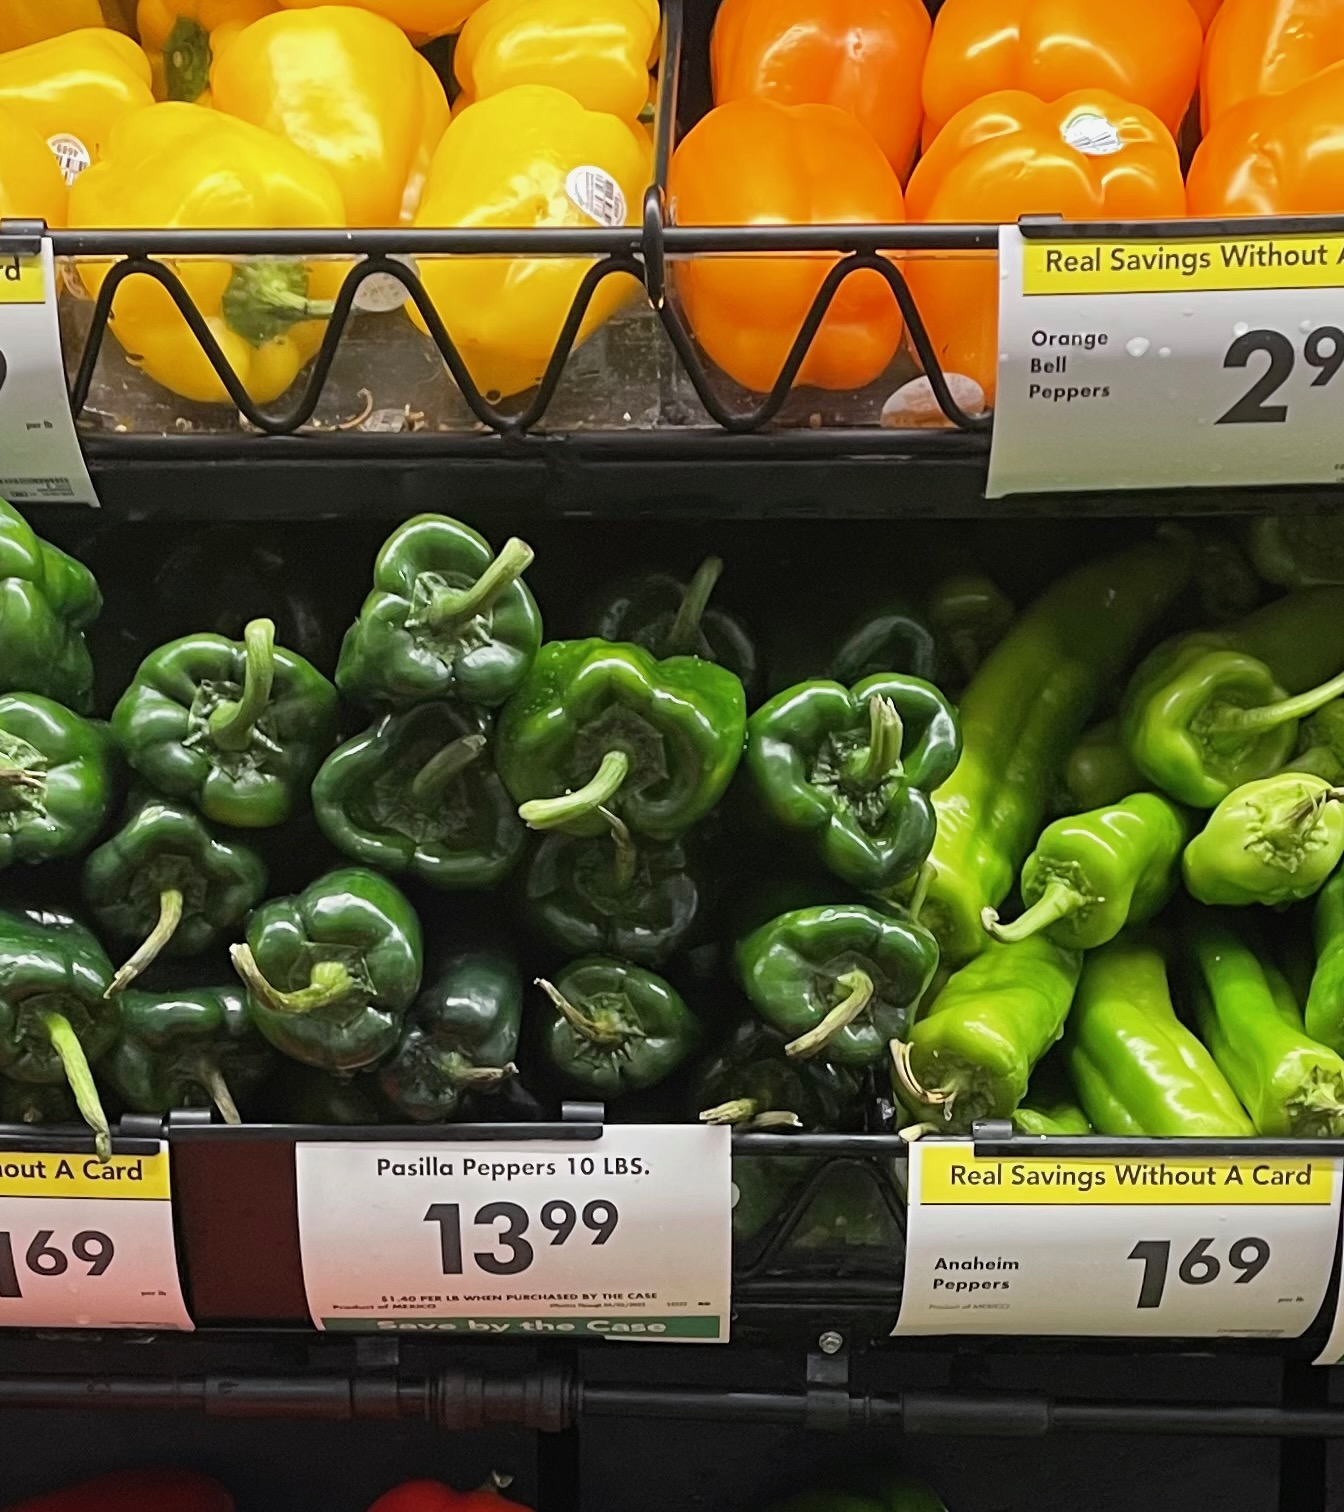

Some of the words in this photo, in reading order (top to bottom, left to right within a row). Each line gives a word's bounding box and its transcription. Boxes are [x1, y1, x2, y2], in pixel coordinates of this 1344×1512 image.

[1032, 330, 1108, 350] Orange
[1031, 356, 1066, 373] Bell
[1030, 384, 1109, 402] Peppers
[378, 1157, 453, 1176] Pasilla
[464, 1159, 555, 1181] Peppers
[568, 1158, 594, 1175] 10
[604, 1158, 649, 1174] LBS.
[935, 1256, 1018, 1270] Anaheim
[933, 1279, 1009, 1292] Peppers
[377, 1320, 455, 1332] Save
[469, 1320, 510, 1334] by
